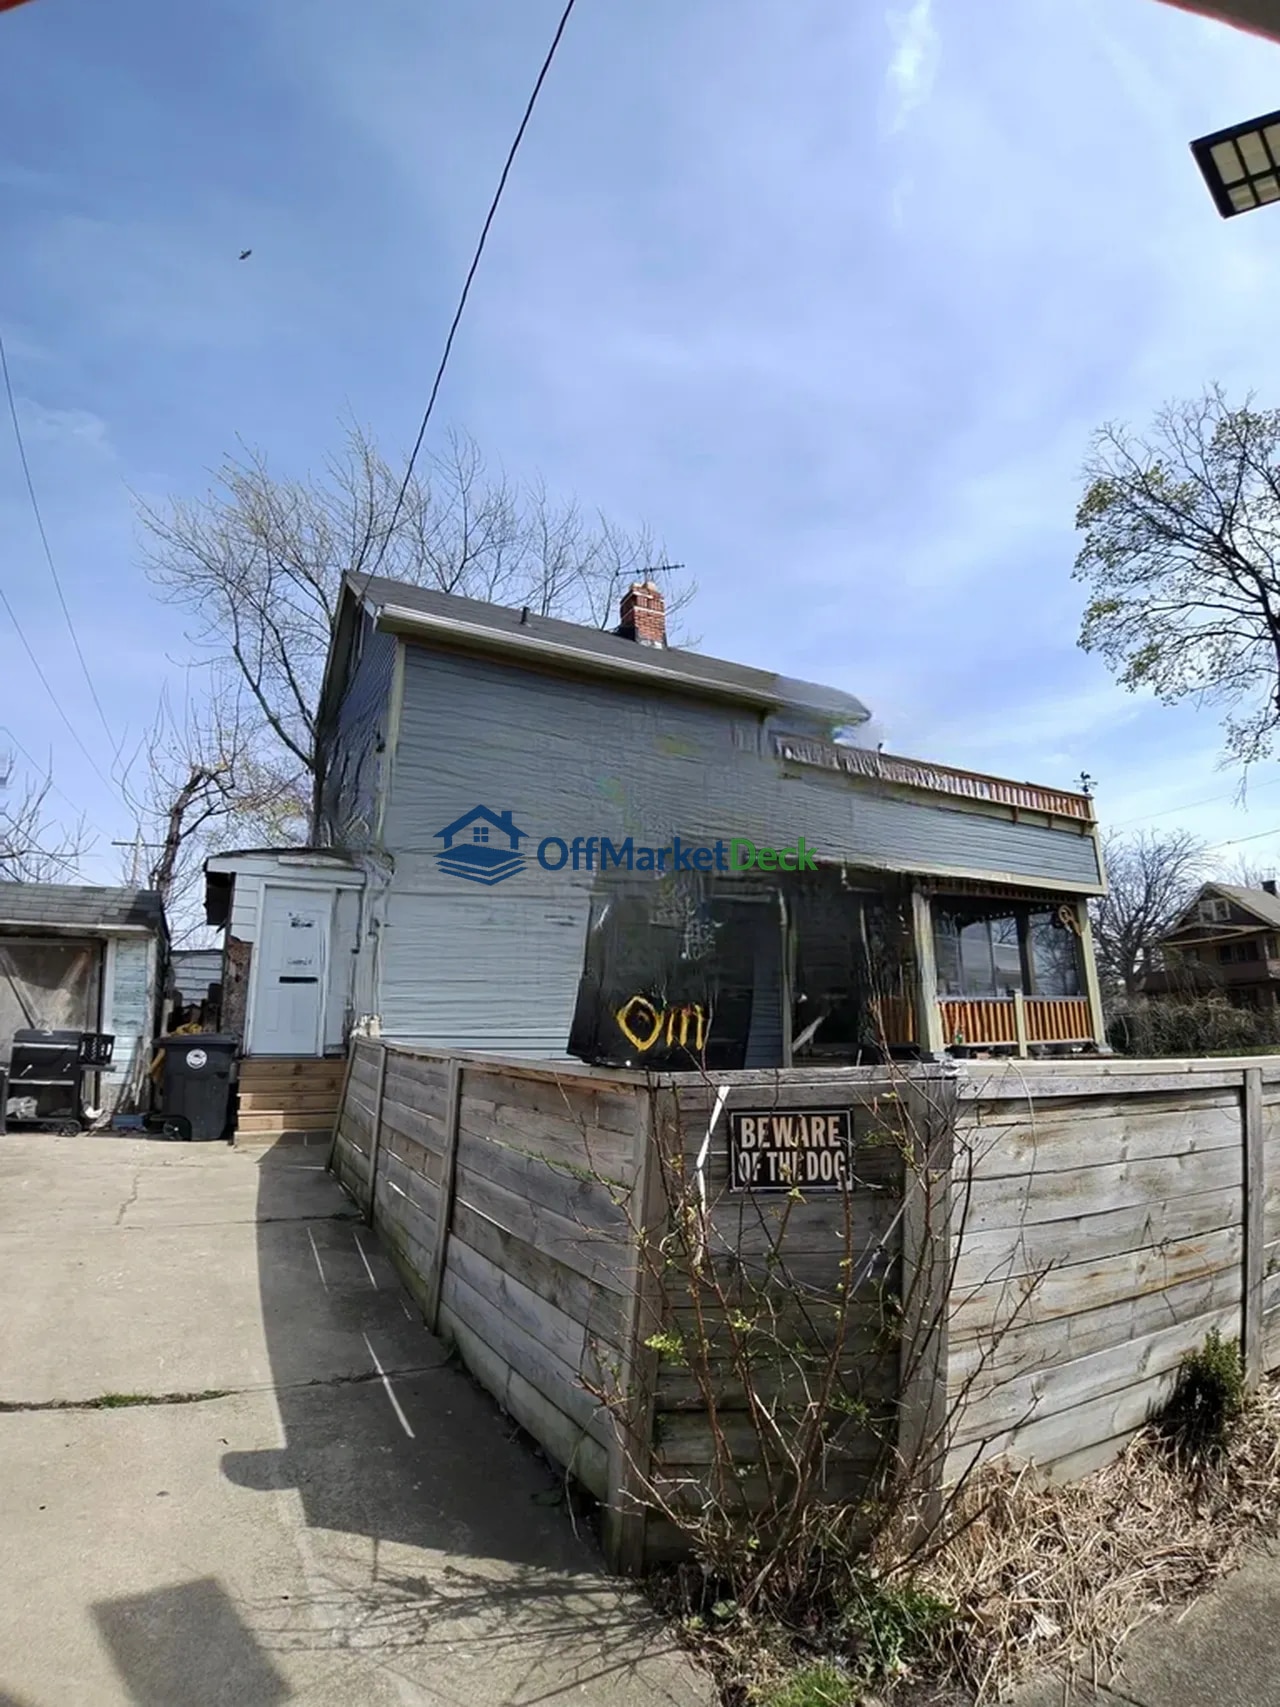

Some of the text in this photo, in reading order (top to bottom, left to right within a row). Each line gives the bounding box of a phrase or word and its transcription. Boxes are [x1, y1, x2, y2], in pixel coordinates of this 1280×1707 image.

[741, 1115, 841, 1149] BEWARE
[738, 1151, 761, 1182] OF
[805, 1150, 846, 1181] DOG
